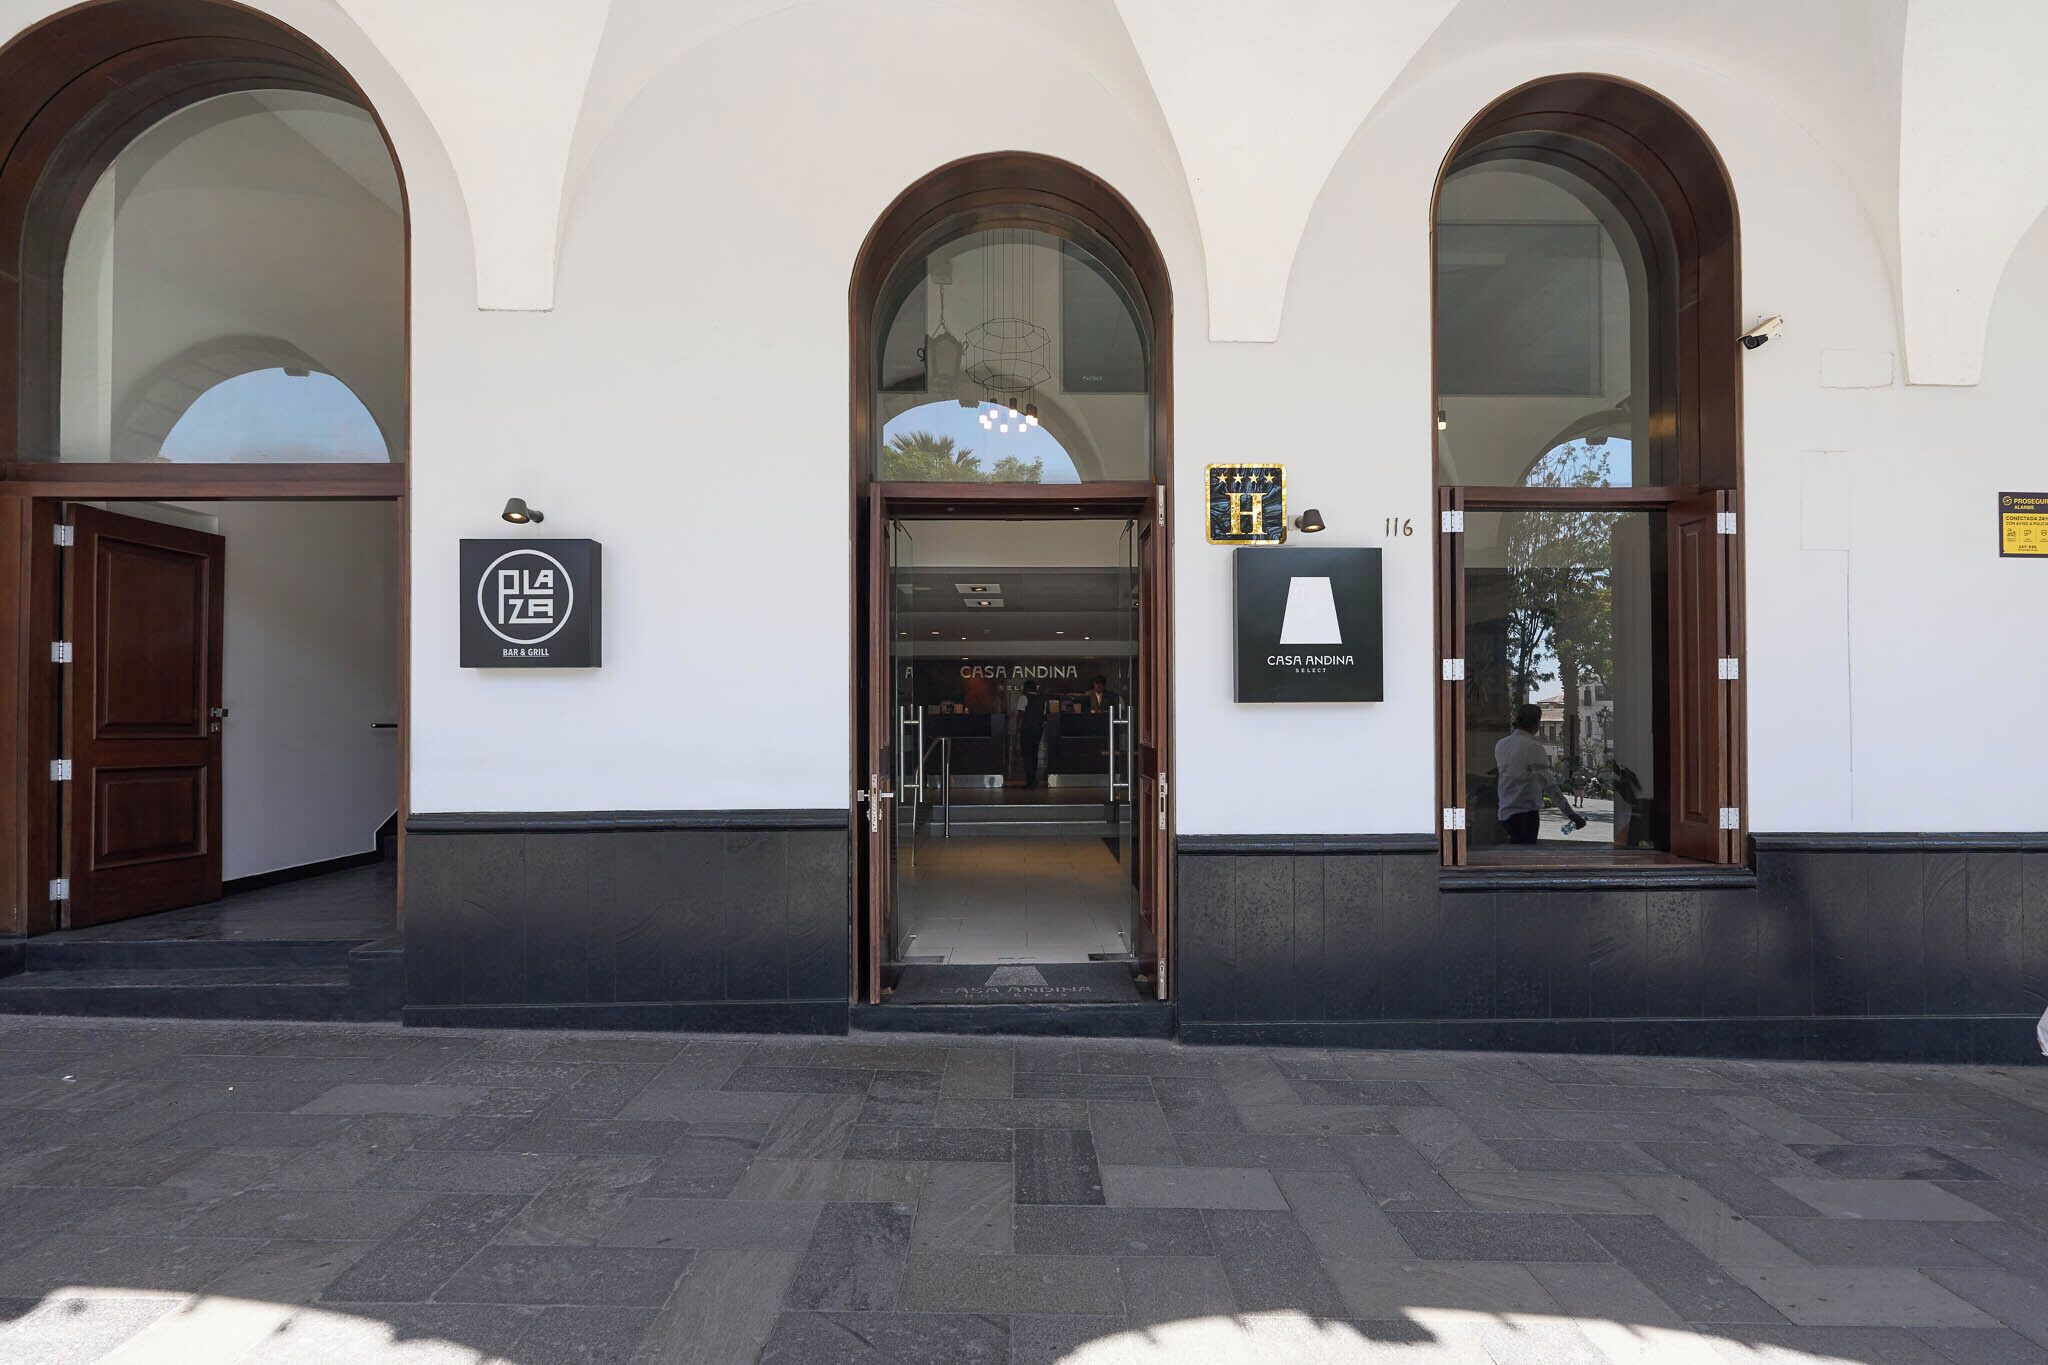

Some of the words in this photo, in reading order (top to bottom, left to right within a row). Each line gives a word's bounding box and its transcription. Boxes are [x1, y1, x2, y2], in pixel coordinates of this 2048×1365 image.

[1385, 517, 1414, 537] 116
[502, 648, 519, 656] BAR
[519, 648, 526, 656] &
[527, 648, 550, 656] GRILL
[1267, 655, 1302, 666] CASA
[1305, 655, 1354, 666] ANDINA
[960, 665, 1007, 679] CASA
[1012, 665, 1078, 679] ANDINA
